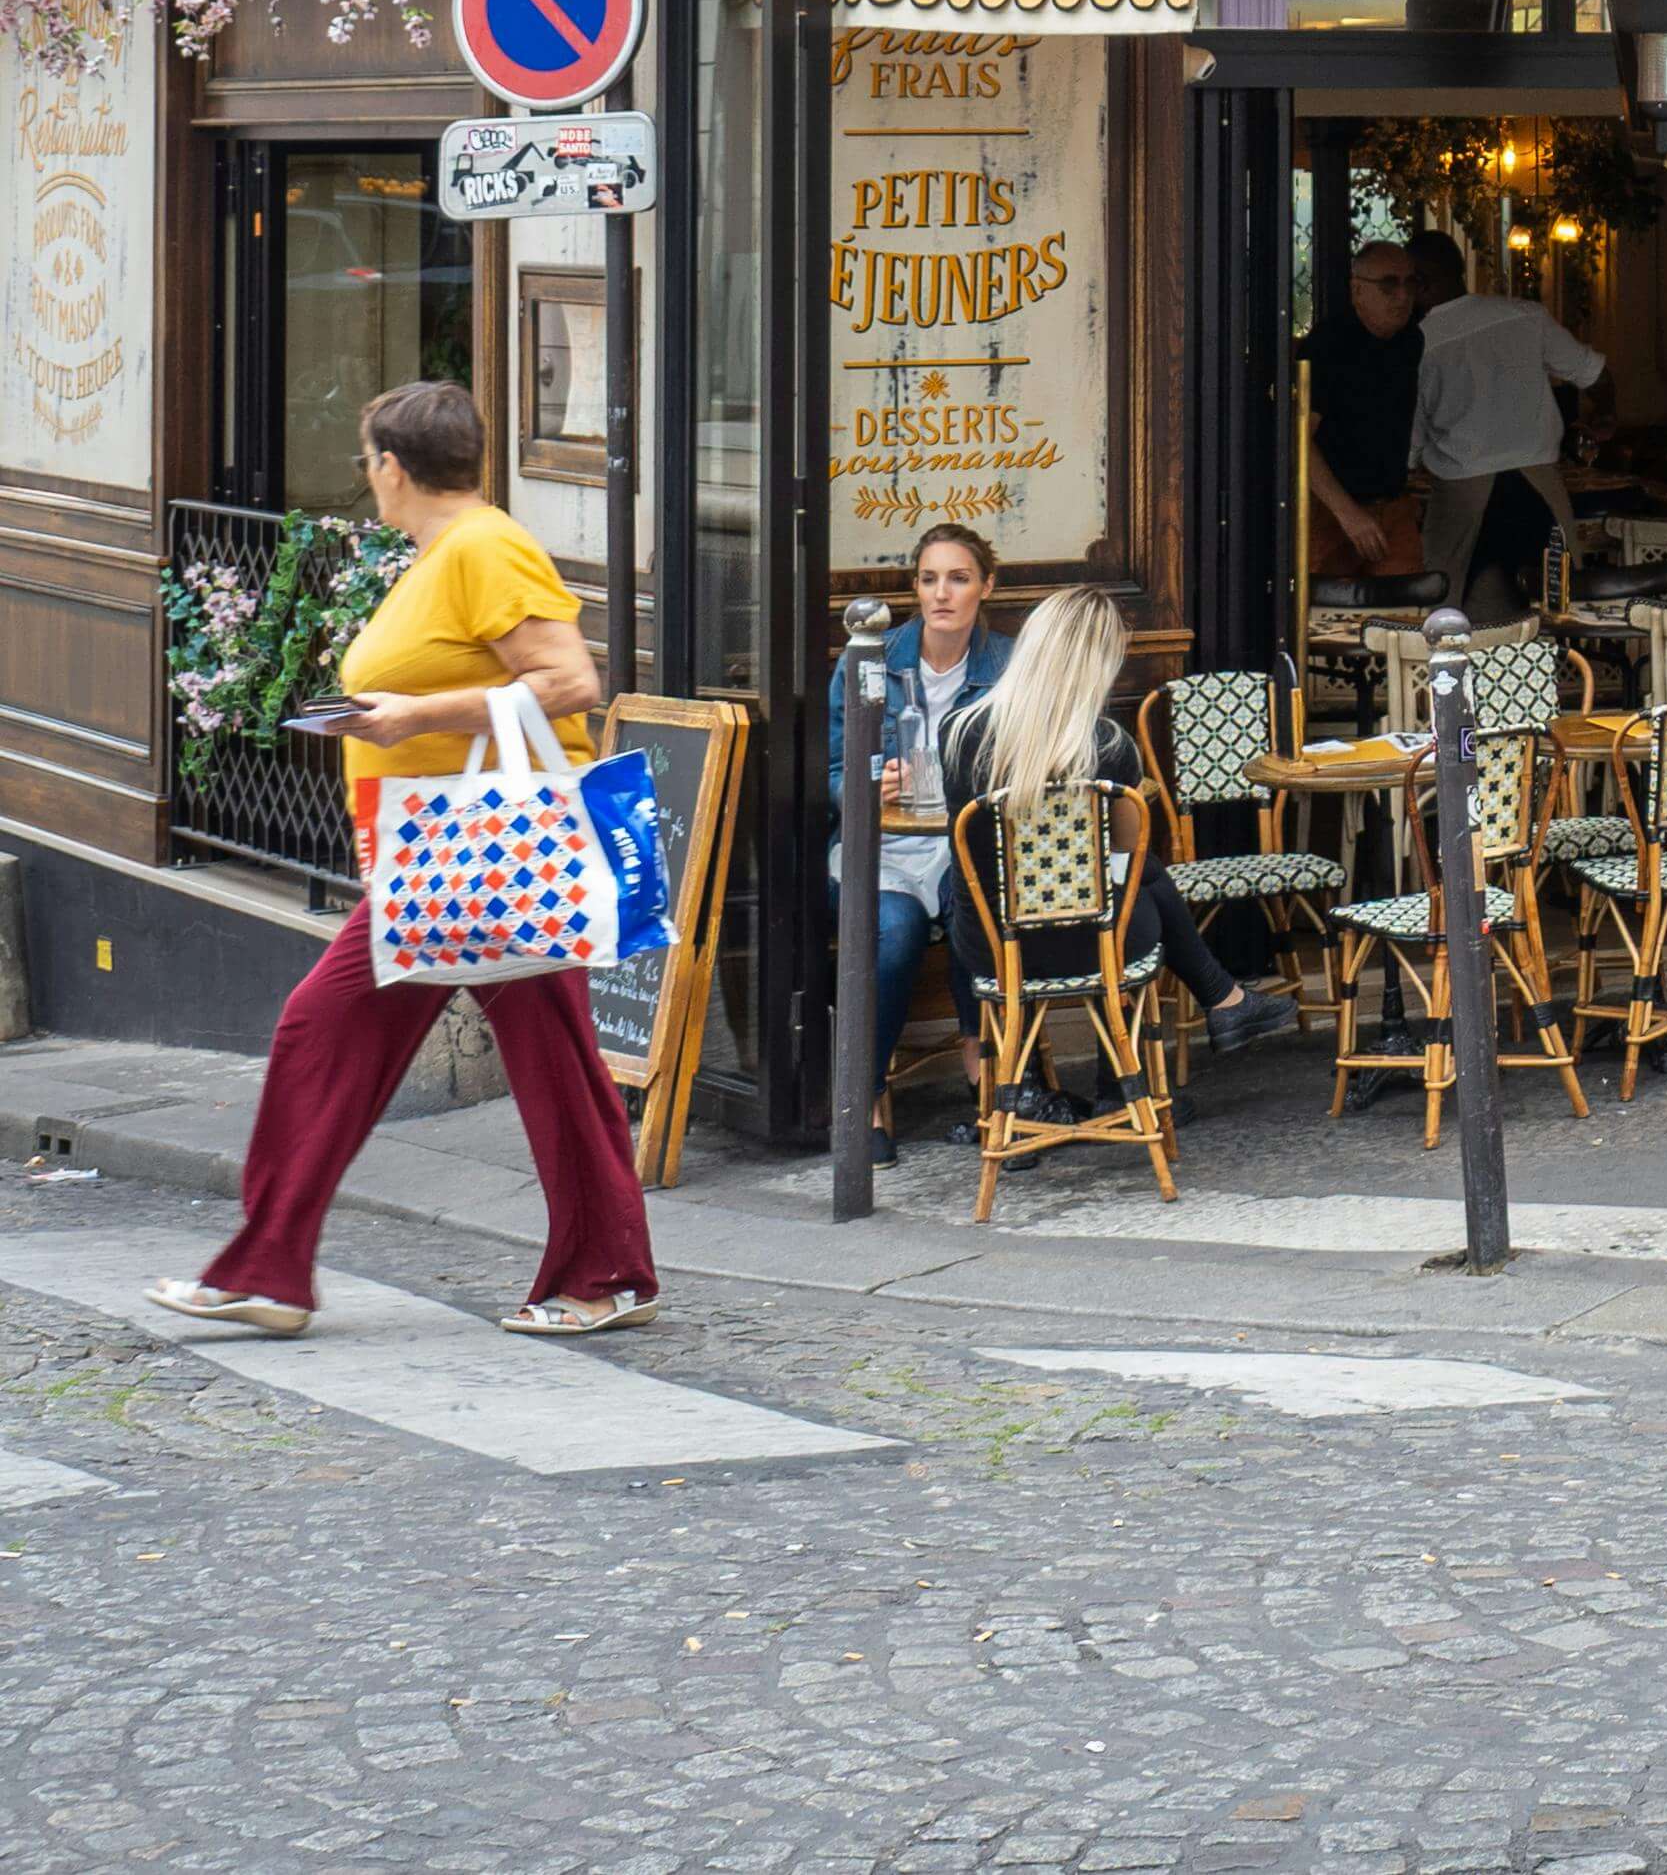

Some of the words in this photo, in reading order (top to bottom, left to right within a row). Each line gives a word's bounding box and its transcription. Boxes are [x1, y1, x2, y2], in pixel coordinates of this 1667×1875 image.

[870, 60, 1001, 99] FRAIS
[852, 169, 1016, 229] PETITS
[32, 272, 56, 336] FAIT
[58, 278, 106, 344] MAISON
[831, 231, 1067, 333] ÉJEUNERS
[27, 342, 74, 401] TOUTE
[75, 334, 124, 401] HEURE
[855, 404, 1019, 447] DESSERTS
